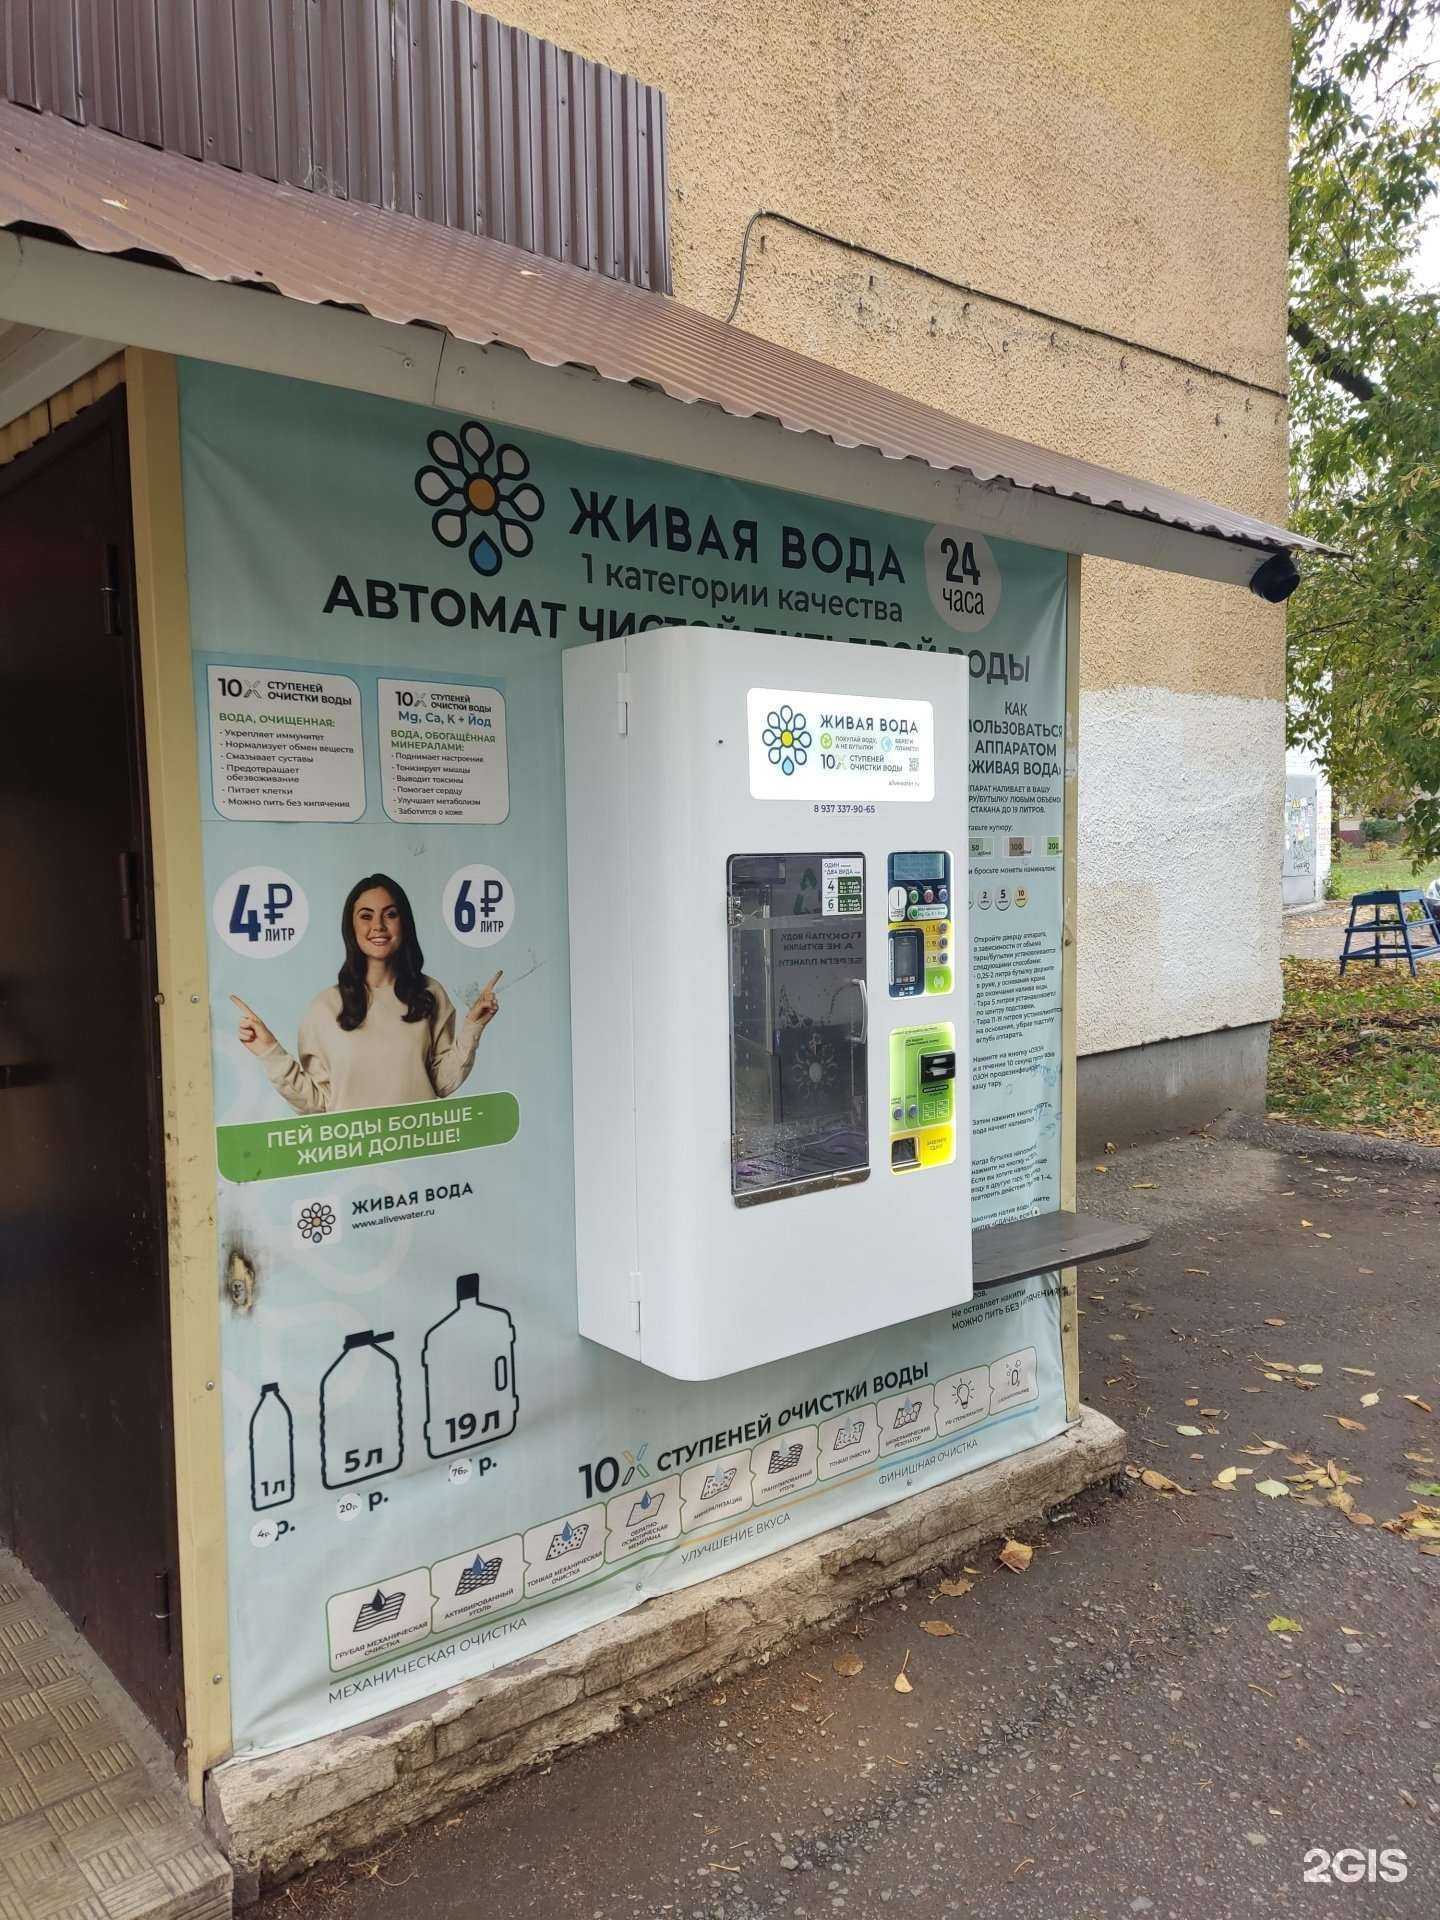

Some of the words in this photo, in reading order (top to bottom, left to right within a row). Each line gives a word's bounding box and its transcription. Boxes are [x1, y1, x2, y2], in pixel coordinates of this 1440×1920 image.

[569, 487, 758, 564] ЖИВАЯ
[782, 525, 906, 586] ВОДА
[940, 537, 981, 586] 24
[581, 553, 593, 584] 1
[606, 563, 768, 608] категории
[778, 588, 903, 623] качества
[322, 574, 567, 638] АВТОМАТ
[942, 587, 985, 616] часа
[267, 681, 323, 693] СТУПЕНЕЙ
[268, 692, 318, 703] ОЧИСТКИ
[322, 696, 352, 705] ВОДЫ
[431, 694, 470, 703] СТУПЕНЕЙ
[431, 702, 466, 711] ОЧИСТКИ
[1005, 701, 1027, 716] КАК
[219, 712, 256, 723] ВОДА,
[398, 711, 422, 724] Mg,
[468, 714, 491, 728] Йод
[820, 714, 873, 731] ЖИВАЯ
[880, 718, 918, 735] ВОДА
[225, 729, 273, 739] Укрепляет
[391, 730, 422, 740] ВОДА,
[225, 741, 287, 750] Нормализует
[392, 741, 464, 751] МИНЕРАЛАМИ:
[975, 740, 1056, 756] АППАРАТОМ
[226, 753, 275, 761] Смазывает
[396, 752, 440, 761] Поднимает
[850, 754, 884, 762] СТУПЕНЕЙ
[227, 765, 299, 774] Предотвращает
[883, 765, 902, 773] ВОДЫ
[227, 774, 299, 783] обезвоживание
[397, 775, 430, 783] Выводит
[397, 786, 434, 794] Помогает
[821, 805, 836, 813] 937
[828, 880, 835, 891] 4
[1000, 890, 1006, 898] 5
[828, 899, 834, 909] 6
[479, 919, 505, 934] ЛИТР
[264, 926, 295, 944] ЛИТР
[267, 1125, 313, 1149] ПЕЙ
[320, 1118, 382, 1142] ВОДЫ
[388, 1106, 473, 1131] БОЛЬШЕ
[297, 1143, 363, 1166] ЖИВИ
[367, 1128, 461, 1158] ДОЛЬШЕ!
[352, 1190, 419, 1215] ЖИВАЯ
[425, 1182, 473, 1202] ВОДА
[352, 1208, 435, 1229] www.alivewater.ru
[951, 1308, 961, 1319] Не
[963, 1297, 1000, 1314] оставляет
[952, 1314, 984, 1331] МОЖНО
[984, 1308, 1004, 1321] ПИТЬ
[1005, 1302, 1019, 1313] БЕЗ
[657, 1413, 771, 1473] СТУПЕНЕЙ
[777, 1381, 868, 1427] ОЧИСТКИ
[873, 1361, 929, 1394] ВОДЫ
[878, 1457, 937, 1485] ФИНИШНАЯ
[937, 1439, 978, 1462] ОЧИСТКА
[680, 1526, 754, 1565] УЛУЧШЕНИЕ
[756, 1512, 791, 1535] ВКУСА
[527, 1572, 553, 1588] ТОНКАЯ
[554, 1551, 602, 1576] МЕХАНИЧЕСКАЯ
[551, 1568, 580, 1585] ОЧИСТКА
[444, 1588, 514, 1619] АКТИВИРОВАННЫЙ
[468, 1605, 492, 1617] УГОЛЬ
[335, 1645, 365, 1660] ГРУБАЯ
[366, 1621, 428, 1648] МЕХАНИЧЕСКАЯ
[364, 1639, 401, 1656] ОЧИСТКА
[328, 1644, 455, 1704] МЕХАНИЧЕСКАЯ
[459, 1617, 528, 1652] ОЧИСТКА
